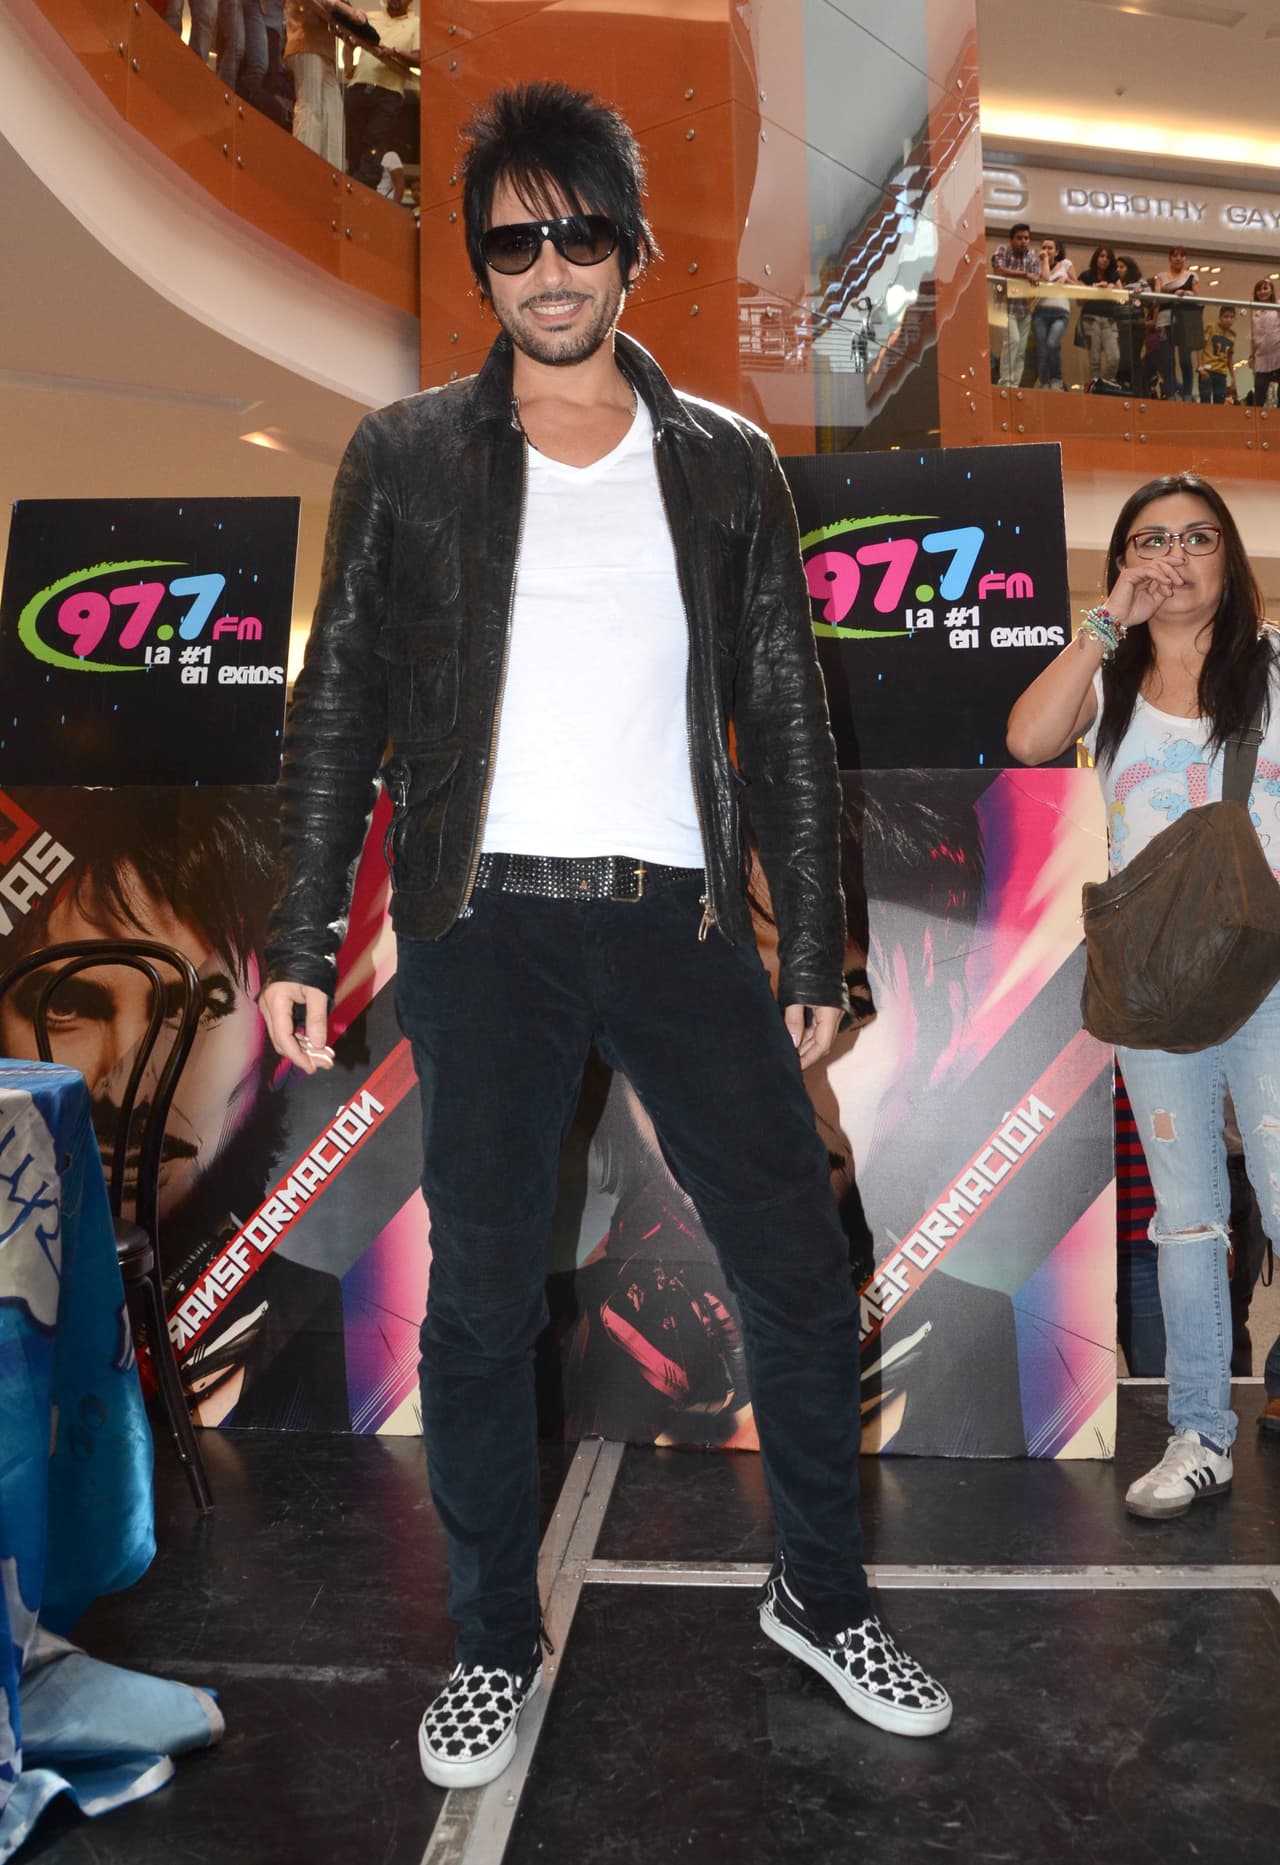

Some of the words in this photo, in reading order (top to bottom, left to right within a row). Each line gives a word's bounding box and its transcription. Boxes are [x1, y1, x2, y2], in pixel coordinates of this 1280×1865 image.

[1066, 187, 1208, 219] DOROTHY
[802, 526, 984, 622] 97.7
[978, 572, 1034, 600] FM
[58, 573, 226, 656] 97.7
[212, 616, 262, 640] FM
[944, 605, 980, 627] #1
[178, 645, 212, 664] #1
[949, 629, 979, 649] en
[181, 666, 208, 684] en
[150, 1089, 385, 1352] RANSFORMACIÓN
[859, 1094, 1056, 1341] NSFORMACIÓN
